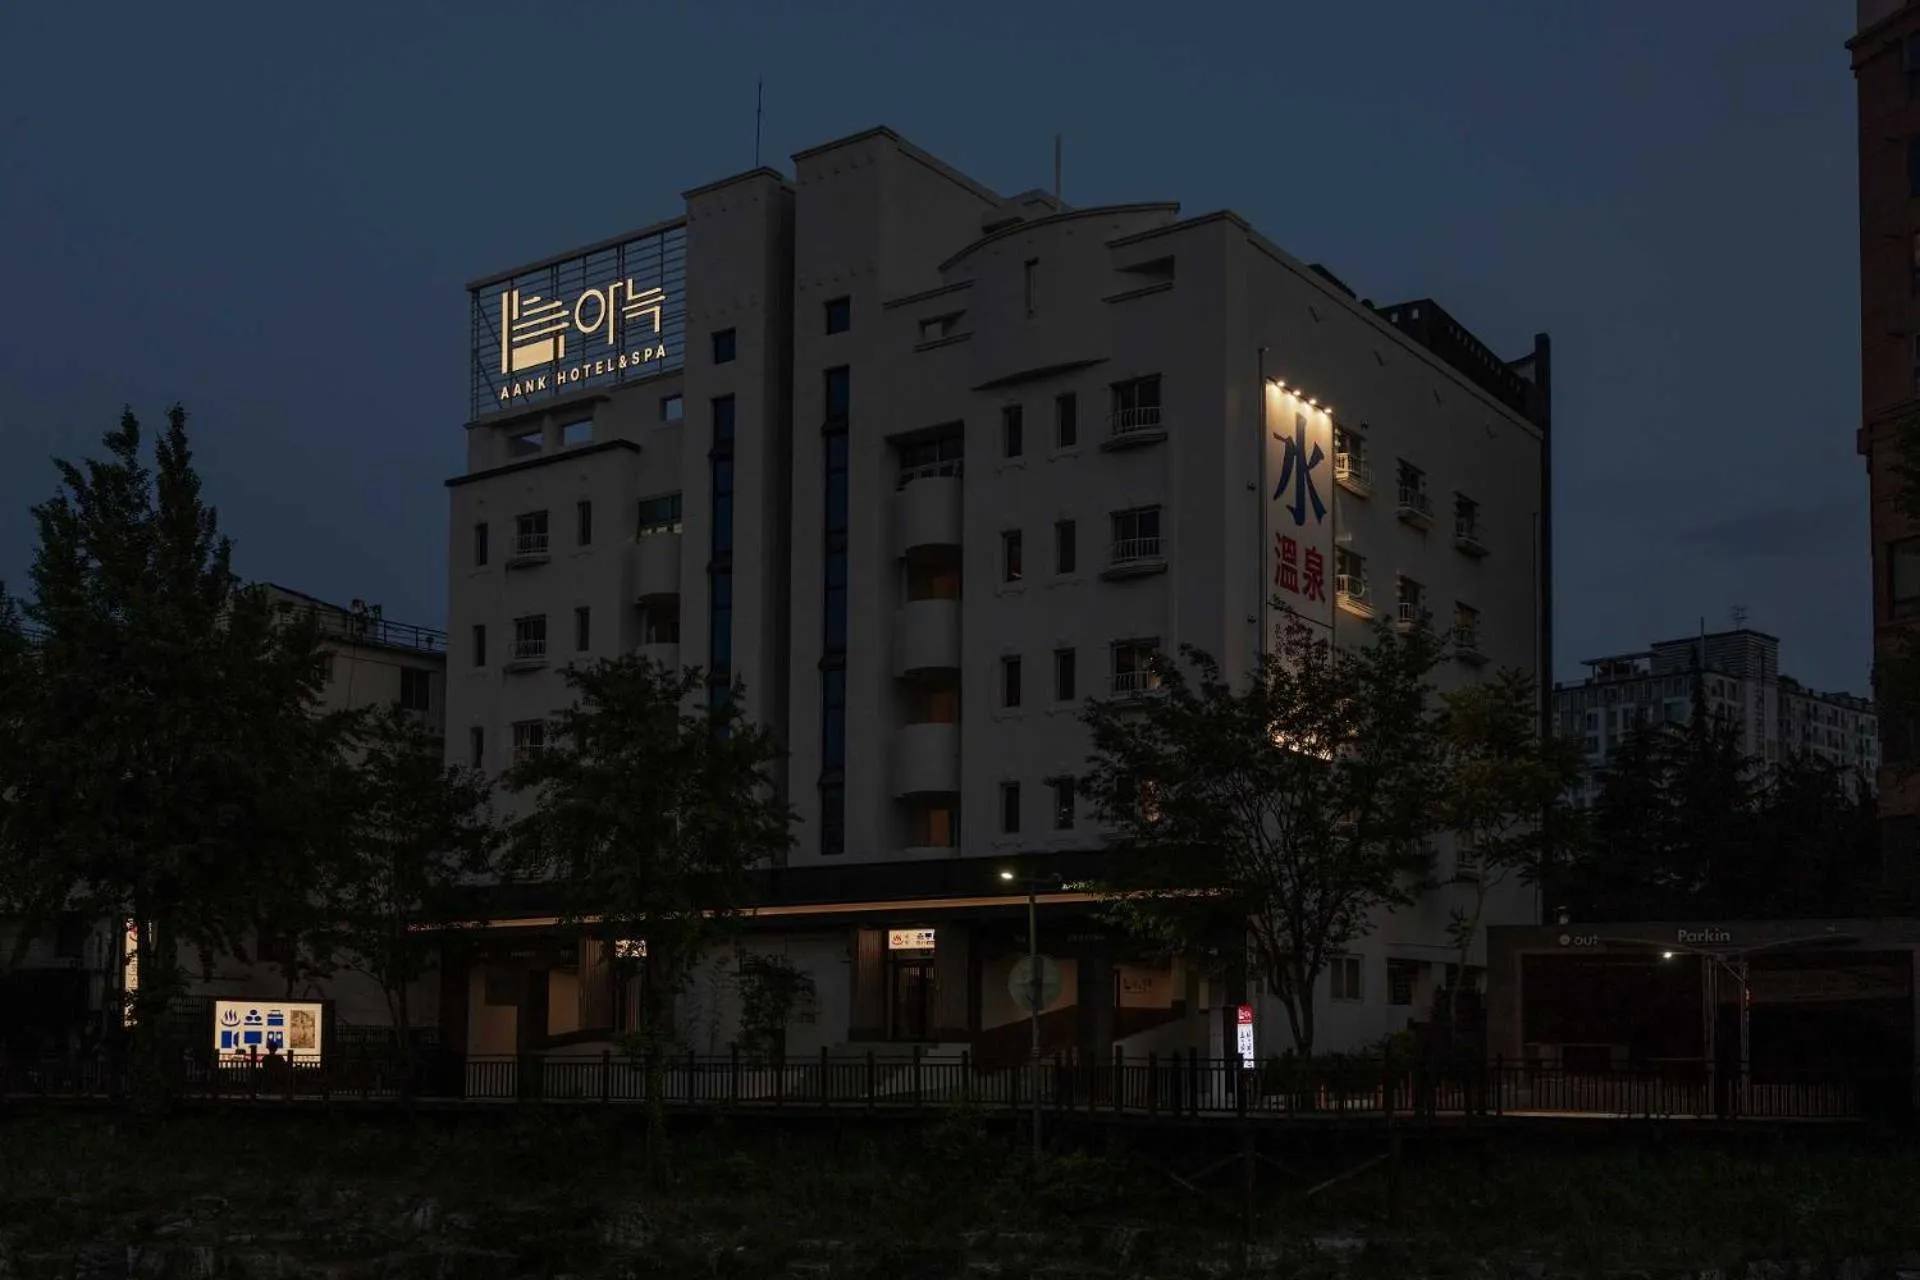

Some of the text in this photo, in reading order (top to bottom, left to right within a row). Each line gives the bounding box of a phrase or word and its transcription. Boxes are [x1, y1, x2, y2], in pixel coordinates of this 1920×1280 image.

[499, 345, 667, 400] AANK HOTEL&SPA
[1273, 412, 1327, 526] 水
